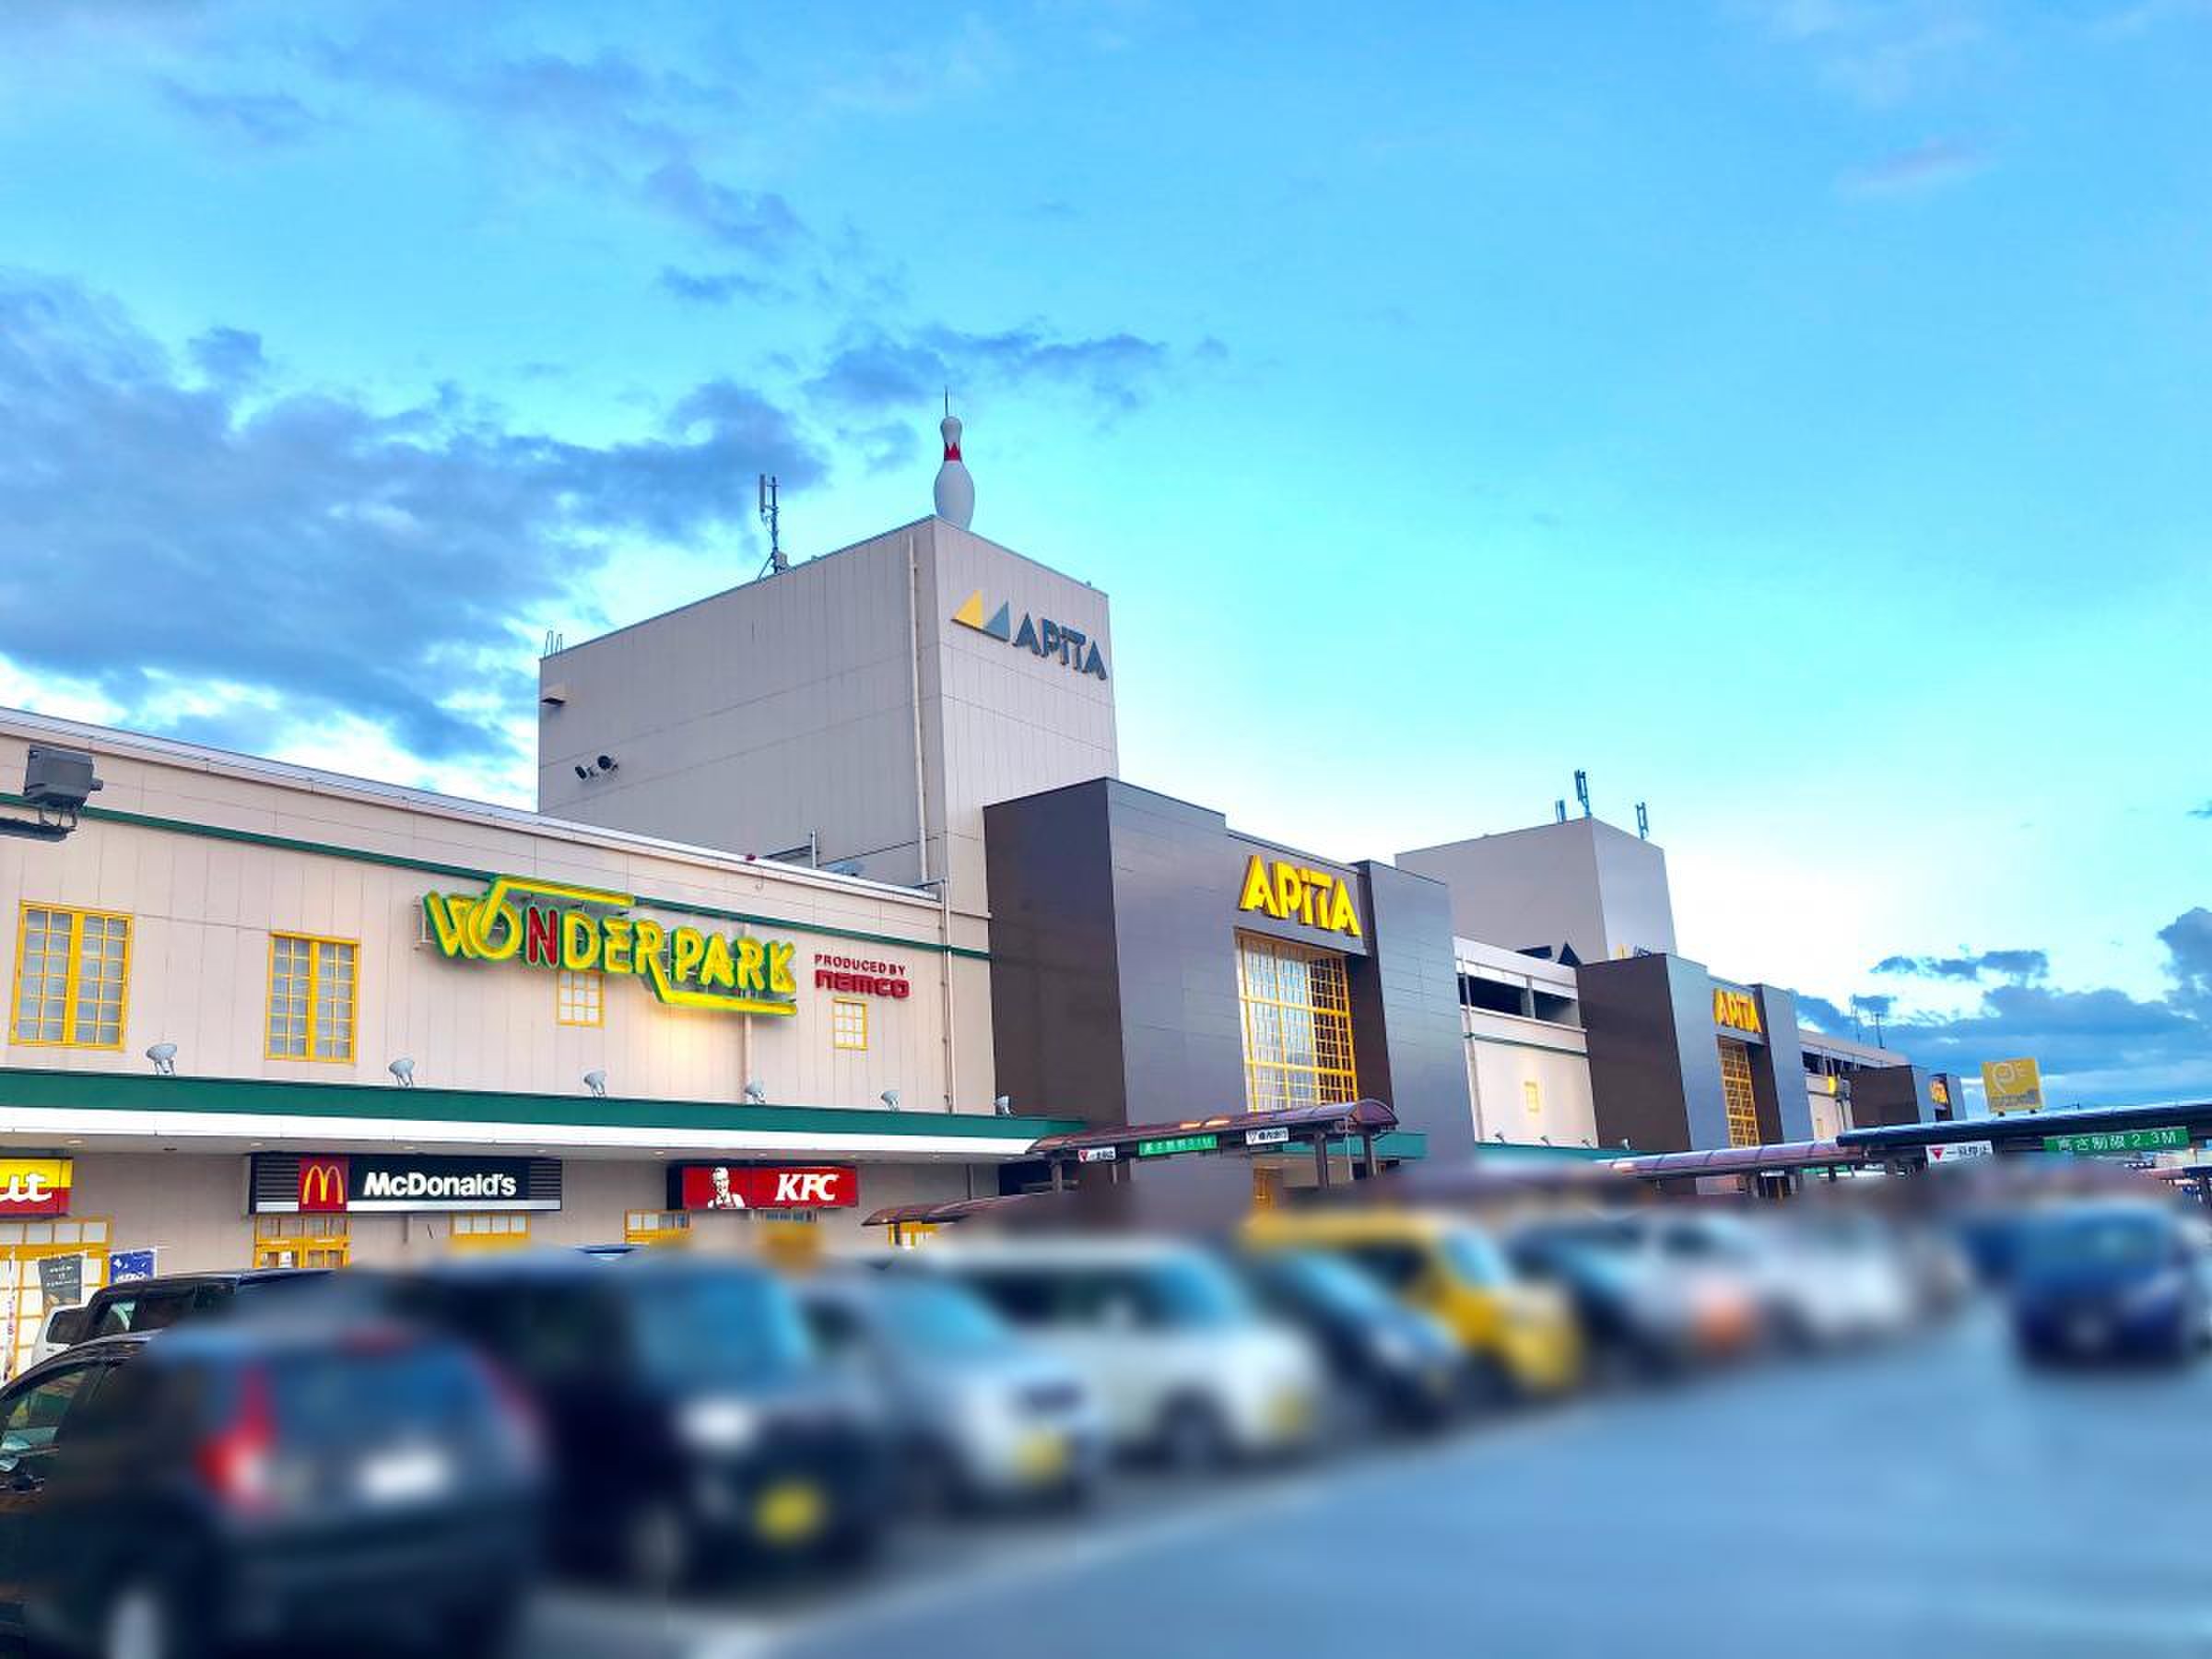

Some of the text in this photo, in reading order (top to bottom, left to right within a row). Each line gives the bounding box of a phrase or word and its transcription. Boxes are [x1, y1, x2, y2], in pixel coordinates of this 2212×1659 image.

[814, 954, 906, 976] PRODUCED BY
[363, 1171, 517, 1197] McDonald's
[776, 1173, 840, 1202] KFC
